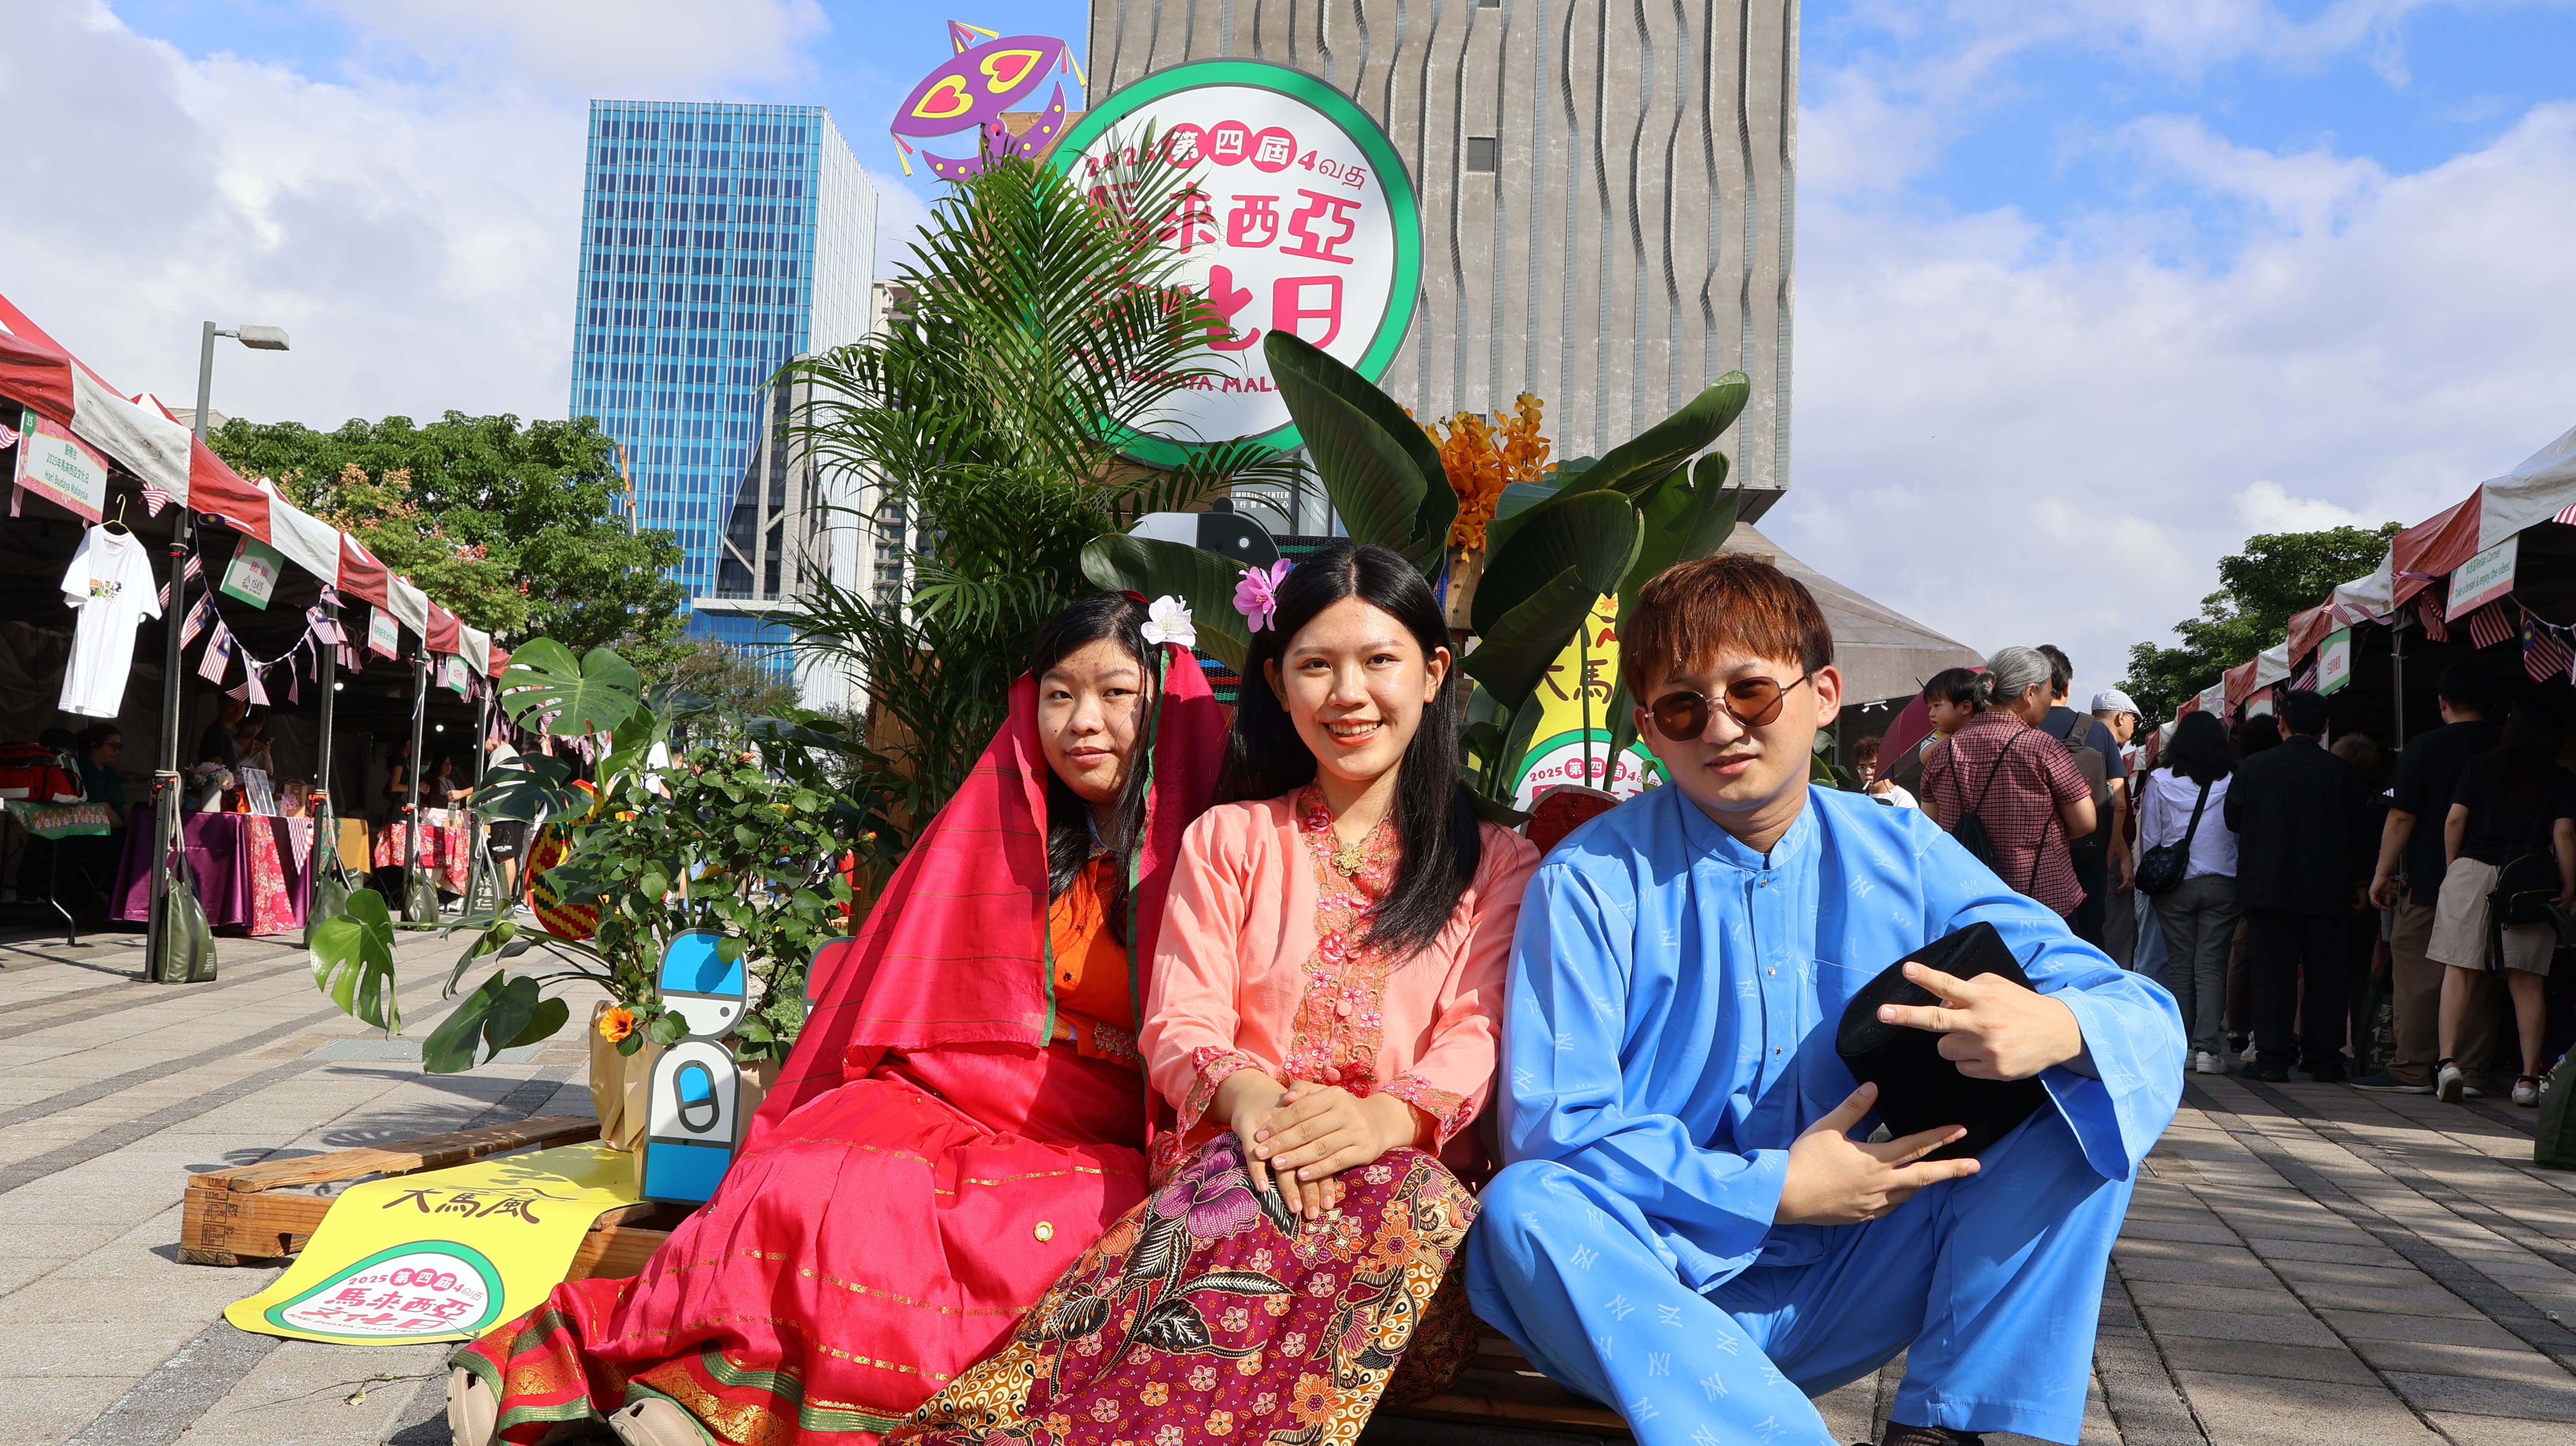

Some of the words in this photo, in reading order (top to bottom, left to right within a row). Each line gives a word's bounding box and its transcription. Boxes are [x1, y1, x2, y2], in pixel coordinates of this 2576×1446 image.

[1080, 261, 1343, 351] 化日
[1222, 377, 1281, 392] MAL
[27, 415, 33, 427] 15
[45, 470, 54, 484] Hari
[55, 474, 70, 492] Budaya
[70, 480, 88, 500] Malaysia
[1529, 766, 1563, 782] 2025
[382, 1188, 540, 1224] 大馬風
[348, 1274, 389, 1285] 2025
[324, 1288, 474, 1320] 馬來西亞
[286, 1313, 313, 1322] HARI
[301, 1307, 447, 1329] 文化日
